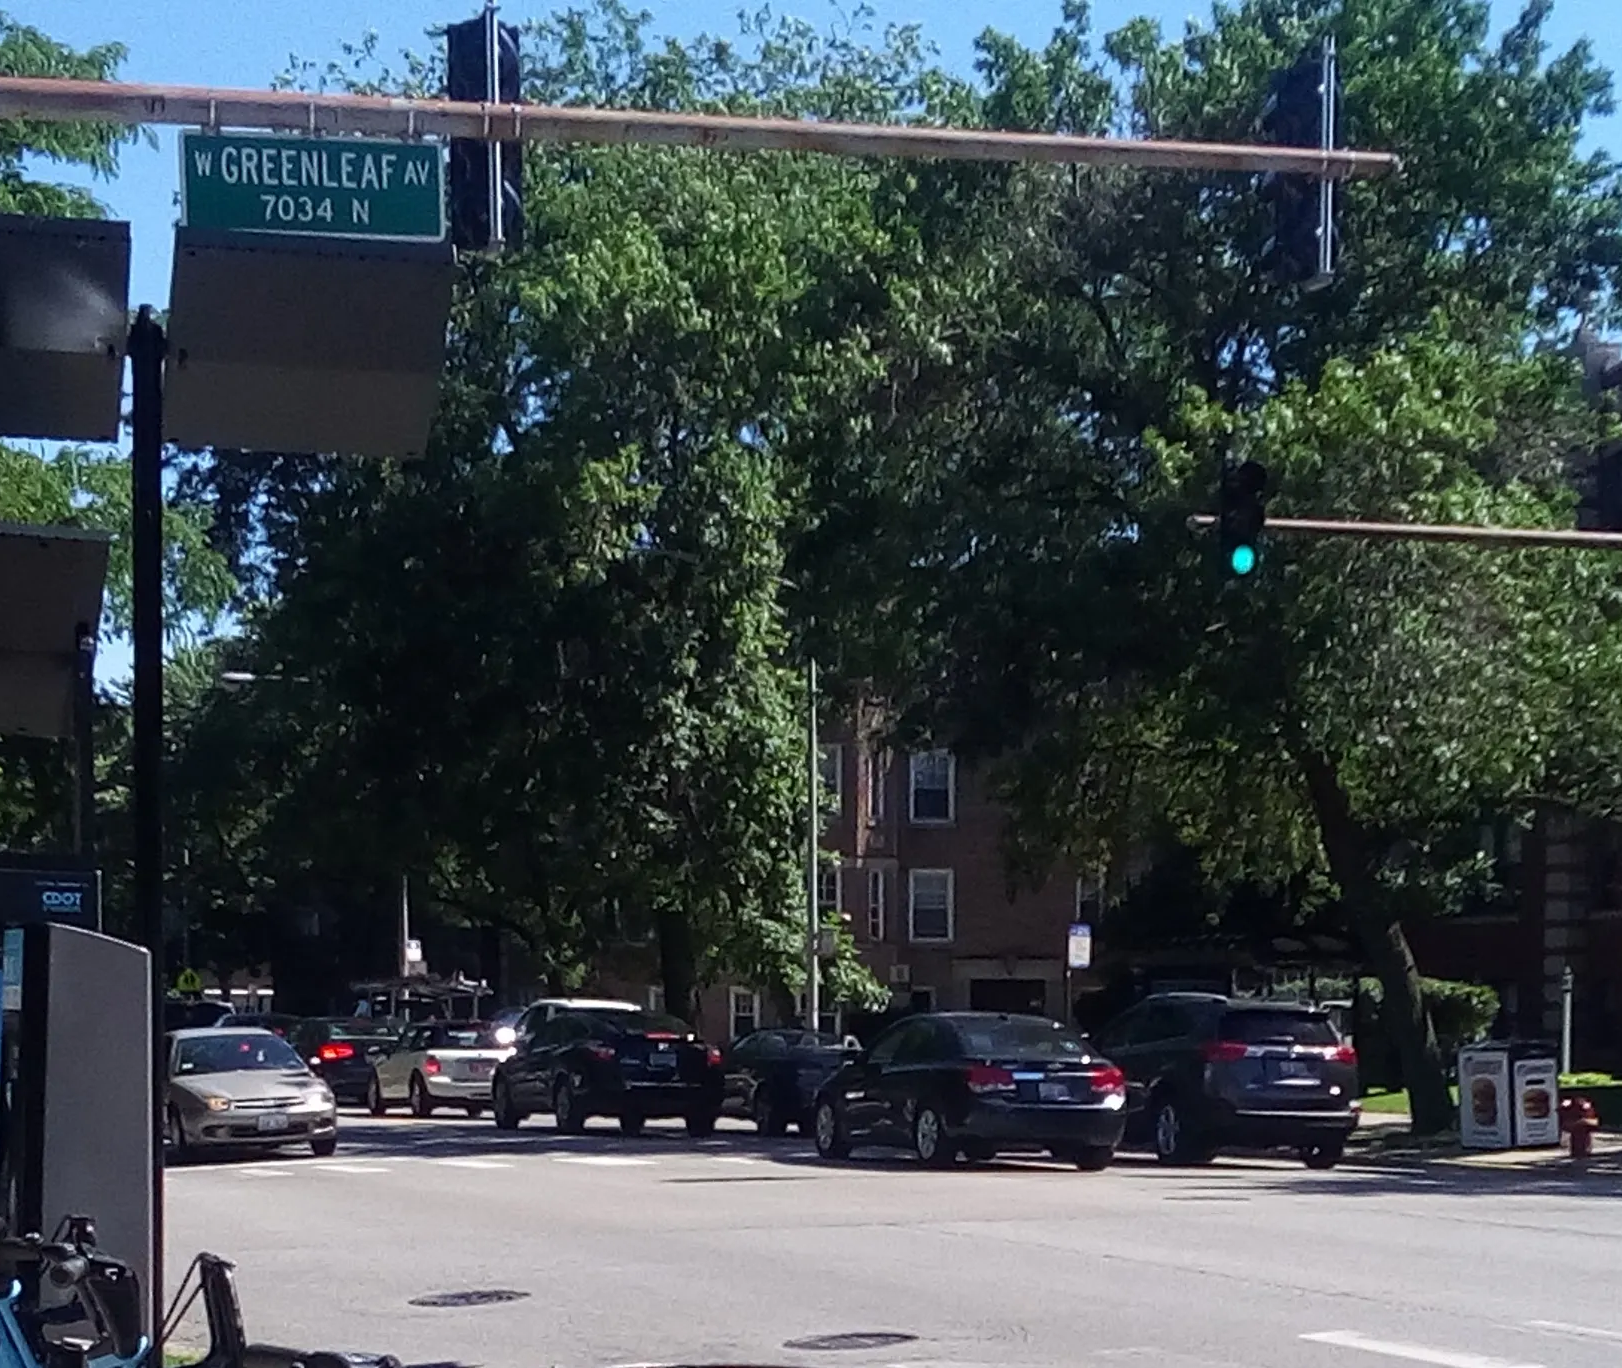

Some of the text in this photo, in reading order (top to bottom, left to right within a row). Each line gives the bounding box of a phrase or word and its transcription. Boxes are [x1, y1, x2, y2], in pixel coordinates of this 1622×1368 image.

[195, 147, 430, 190] W GREENLEAF AV
[260, 195, 370, 225] 7034 N
